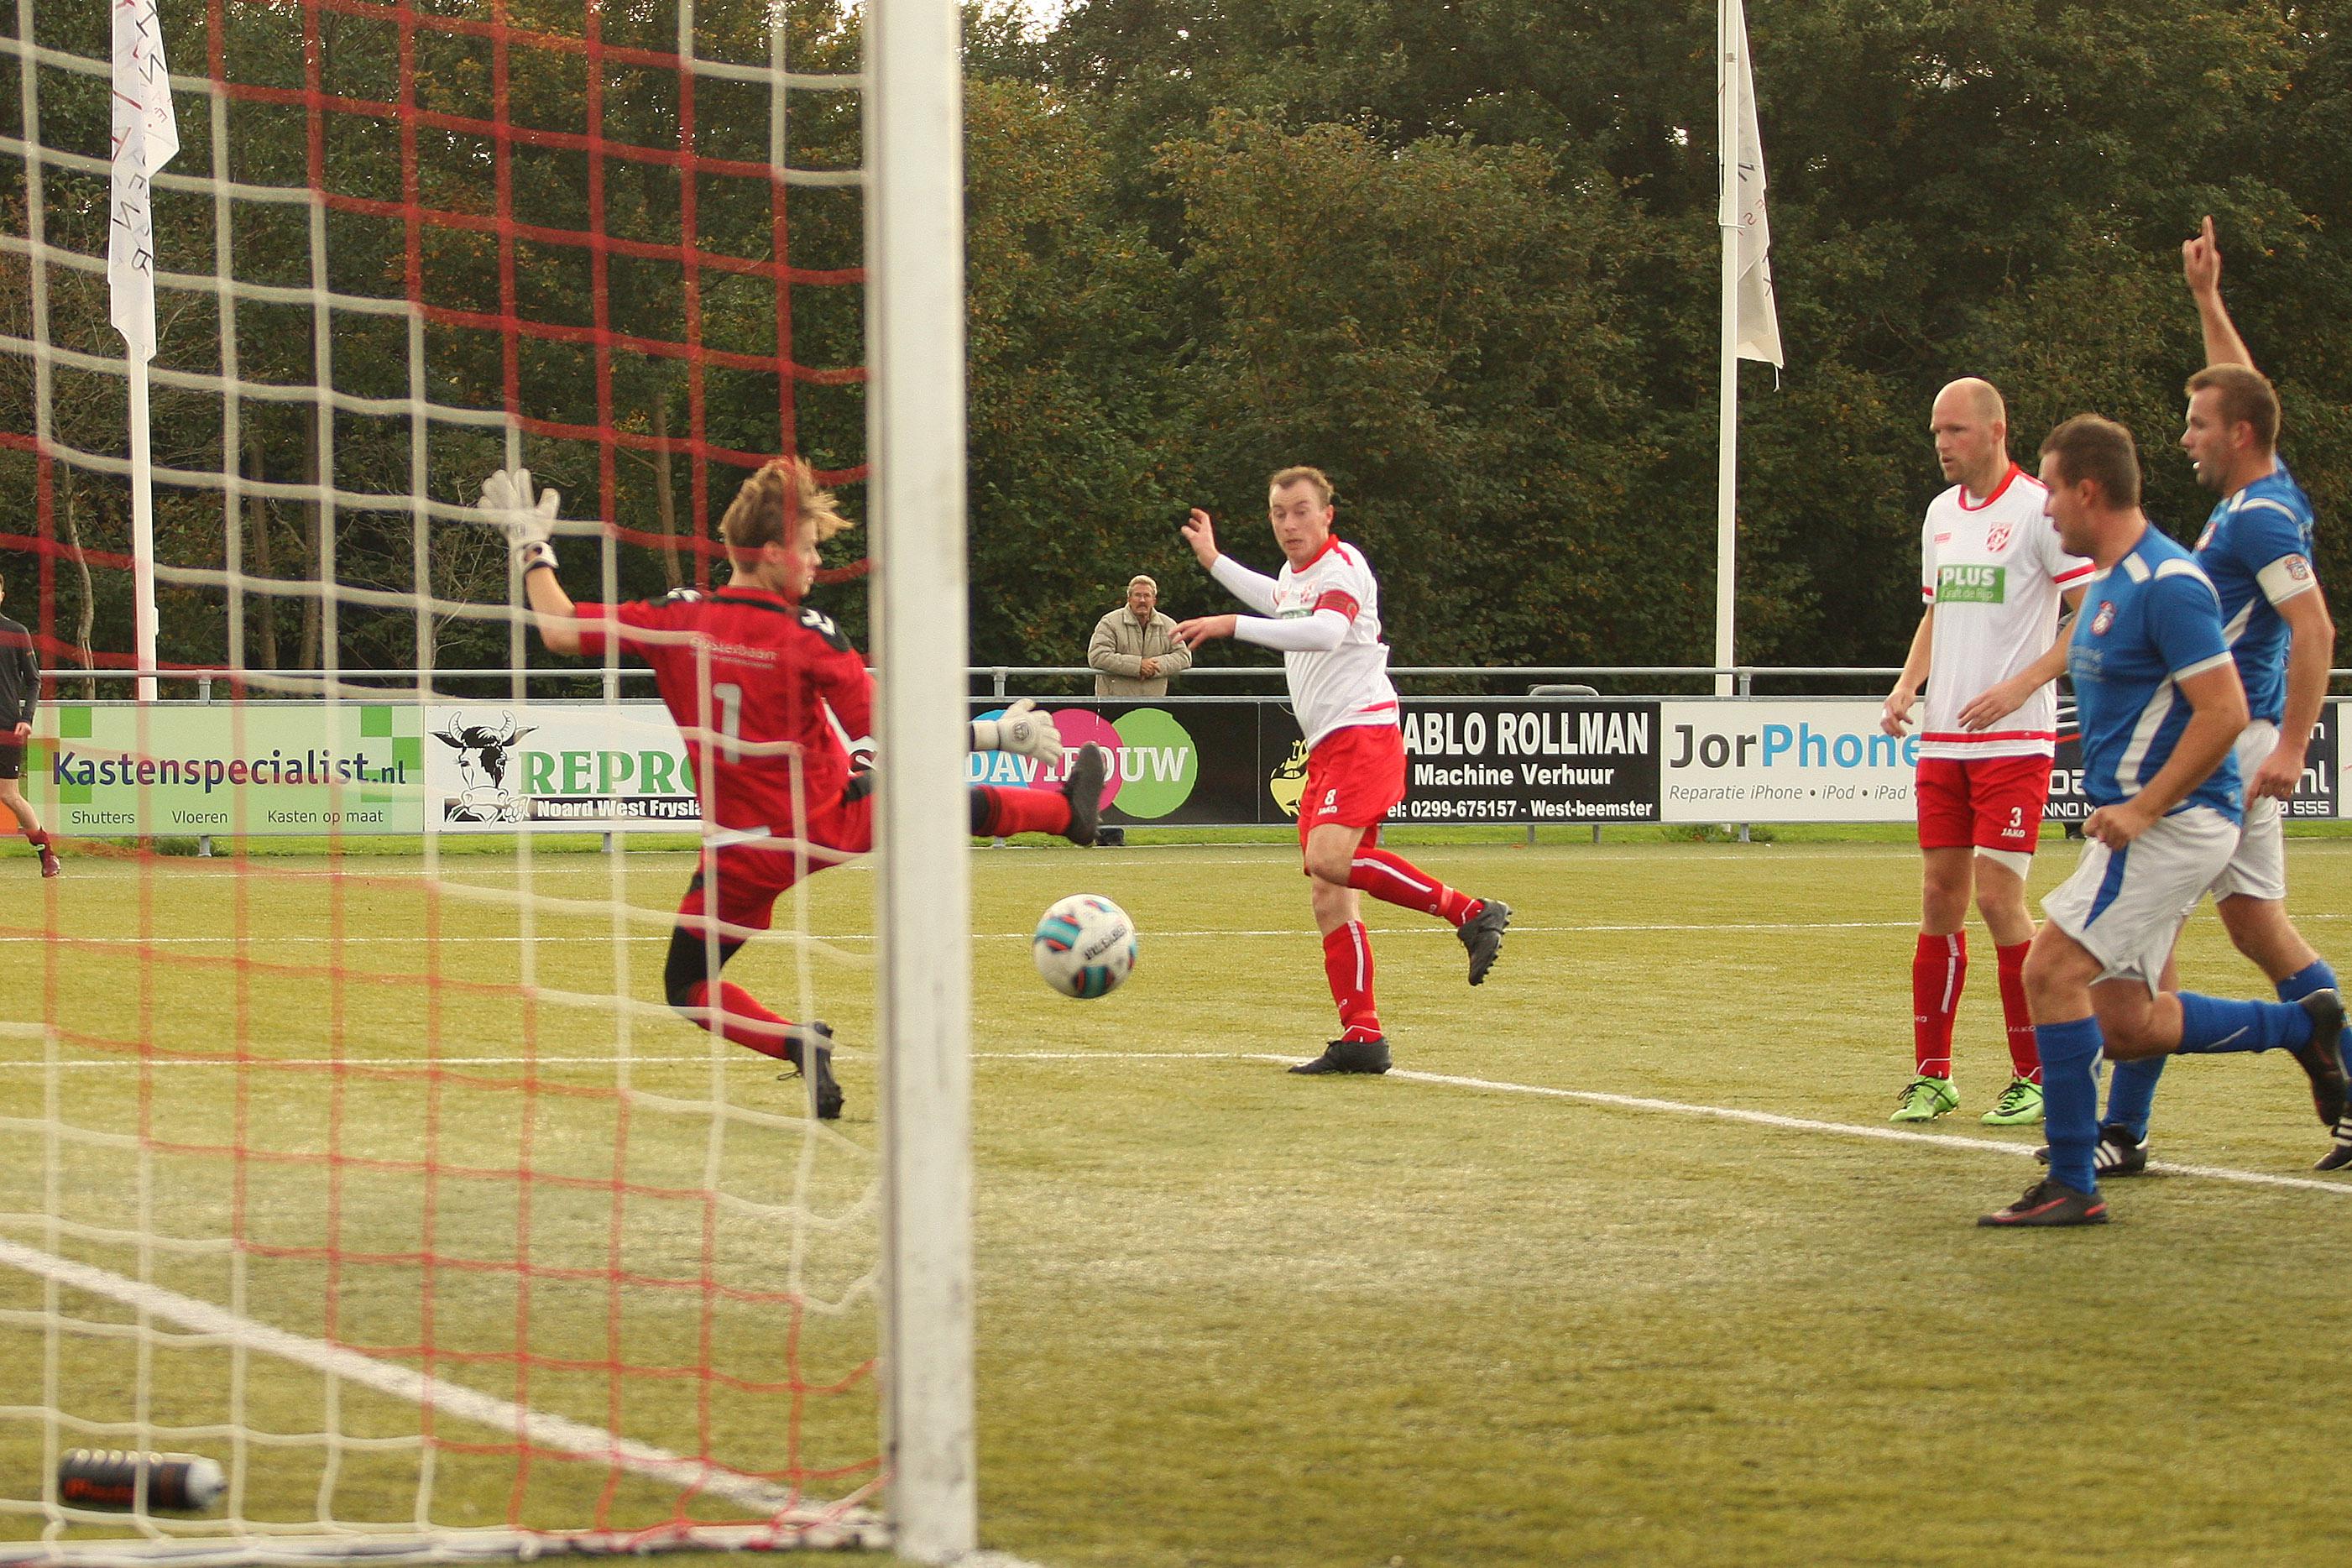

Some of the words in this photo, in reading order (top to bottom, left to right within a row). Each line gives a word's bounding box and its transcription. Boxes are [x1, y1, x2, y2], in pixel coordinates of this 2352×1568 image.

[1942, 567, 1996, 587] PLUS
[713, 682, 741, 765] 1
[1403, 712, 1487, 755] ABLO
[1497, 712, 1649, 755] ROLLMAN
[1670, 722, 1921, 768] JorPhone
[53, 750, 406, 793] Kastenspecialist.nl
[1414, 763, 1513, 786] Machine
[1520, 763, 1614, 786] Verhuur
[1325, 789, 1337, 806] 8
[1669, 785, 1745, 802] Reparatie
[1750, 784, 1803, 799] iPhone
[1821, 785, 1856, 799] iPod
[1874, 785, 1907, 799] iPad
[537, 801, 593, 818] Noard
[598, 801, 646, 818] West
[1387, 801, 1408, 817] el:
[1411, 800, 1517, 818] 0299-675157
[1530, 799, 1653, 818] West-beemster
[2041, 802, 2078, 817] NNO
[2293, 800, 2329, 814] 555
[71, 810, 135, 824] Shutters
[172, 810, 227, 824] Vloeren
[268, 809, 317, 823] Kasten
[322, 813, 341, 828] op
[346, 811, 384, 823] maat
[2010, 807, 2022, 828] 3
